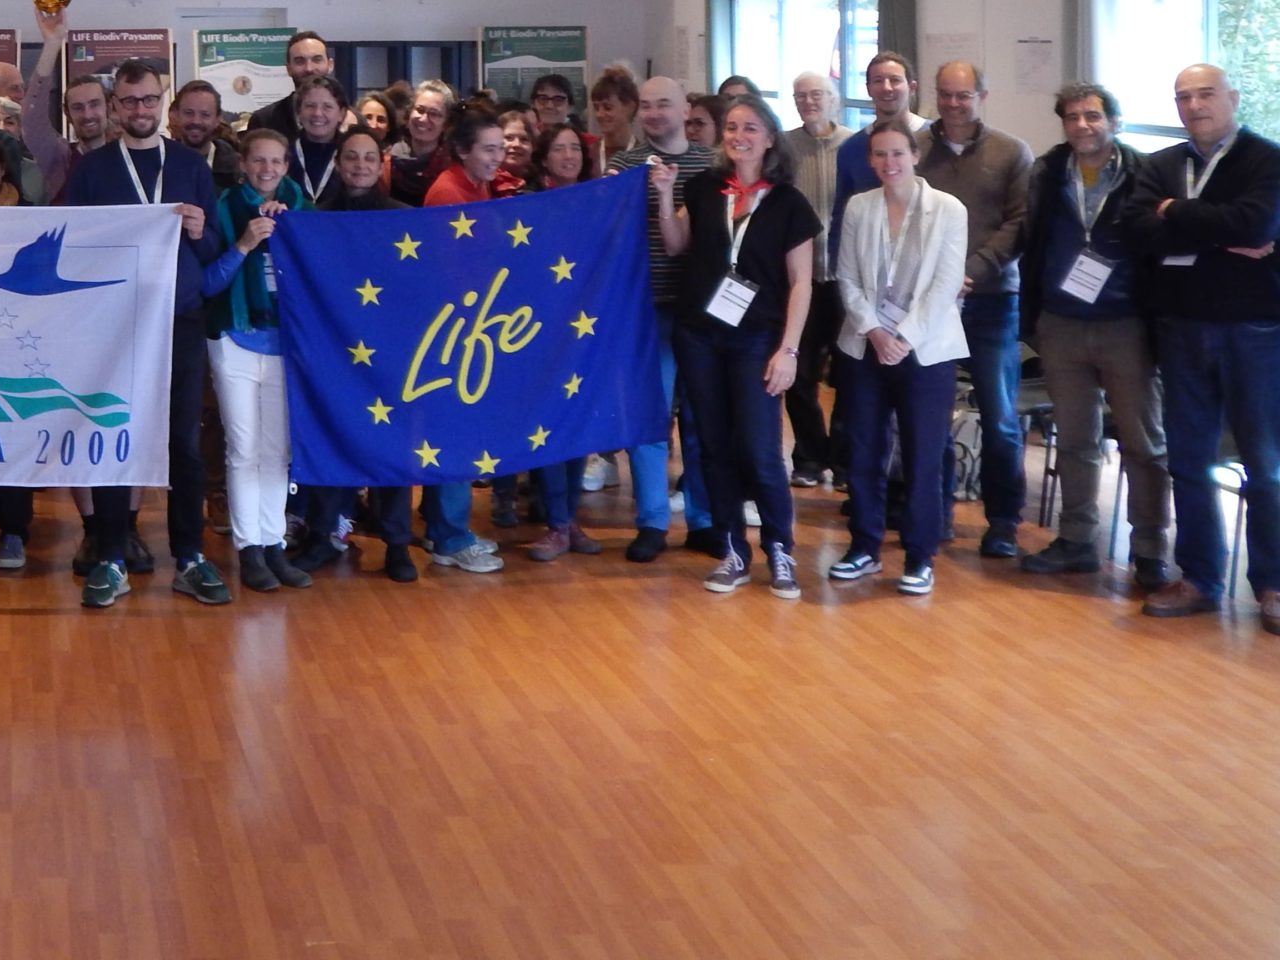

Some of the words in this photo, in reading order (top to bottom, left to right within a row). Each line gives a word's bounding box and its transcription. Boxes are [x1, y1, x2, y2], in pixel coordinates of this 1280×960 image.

[72, 32, 92, 42] LIFE
[202, 34, 221, 44] LIFE
[401, 266, 543, 405] Life
[35, 428, 131, 466] 2000
